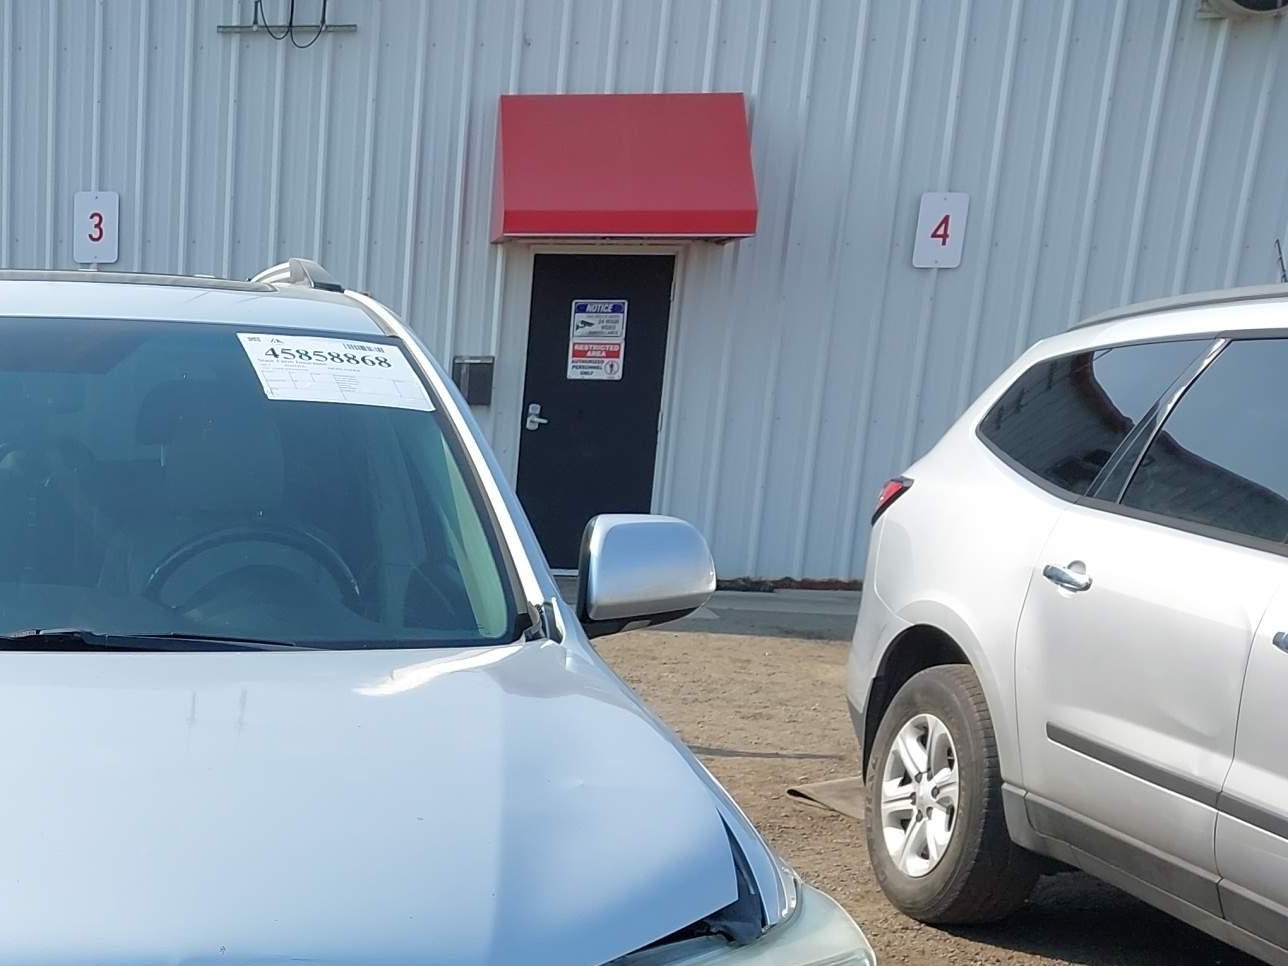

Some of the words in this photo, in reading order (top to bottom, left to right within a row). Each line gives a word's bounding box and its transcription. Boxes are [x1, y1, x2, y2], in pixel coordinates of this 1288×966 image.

[88, 212, 104, 243] 3
[930, 214, 951, 247] 4
[585, 303, 613, 312] NOTICE
[265, 347, 392, 368] 45858868
